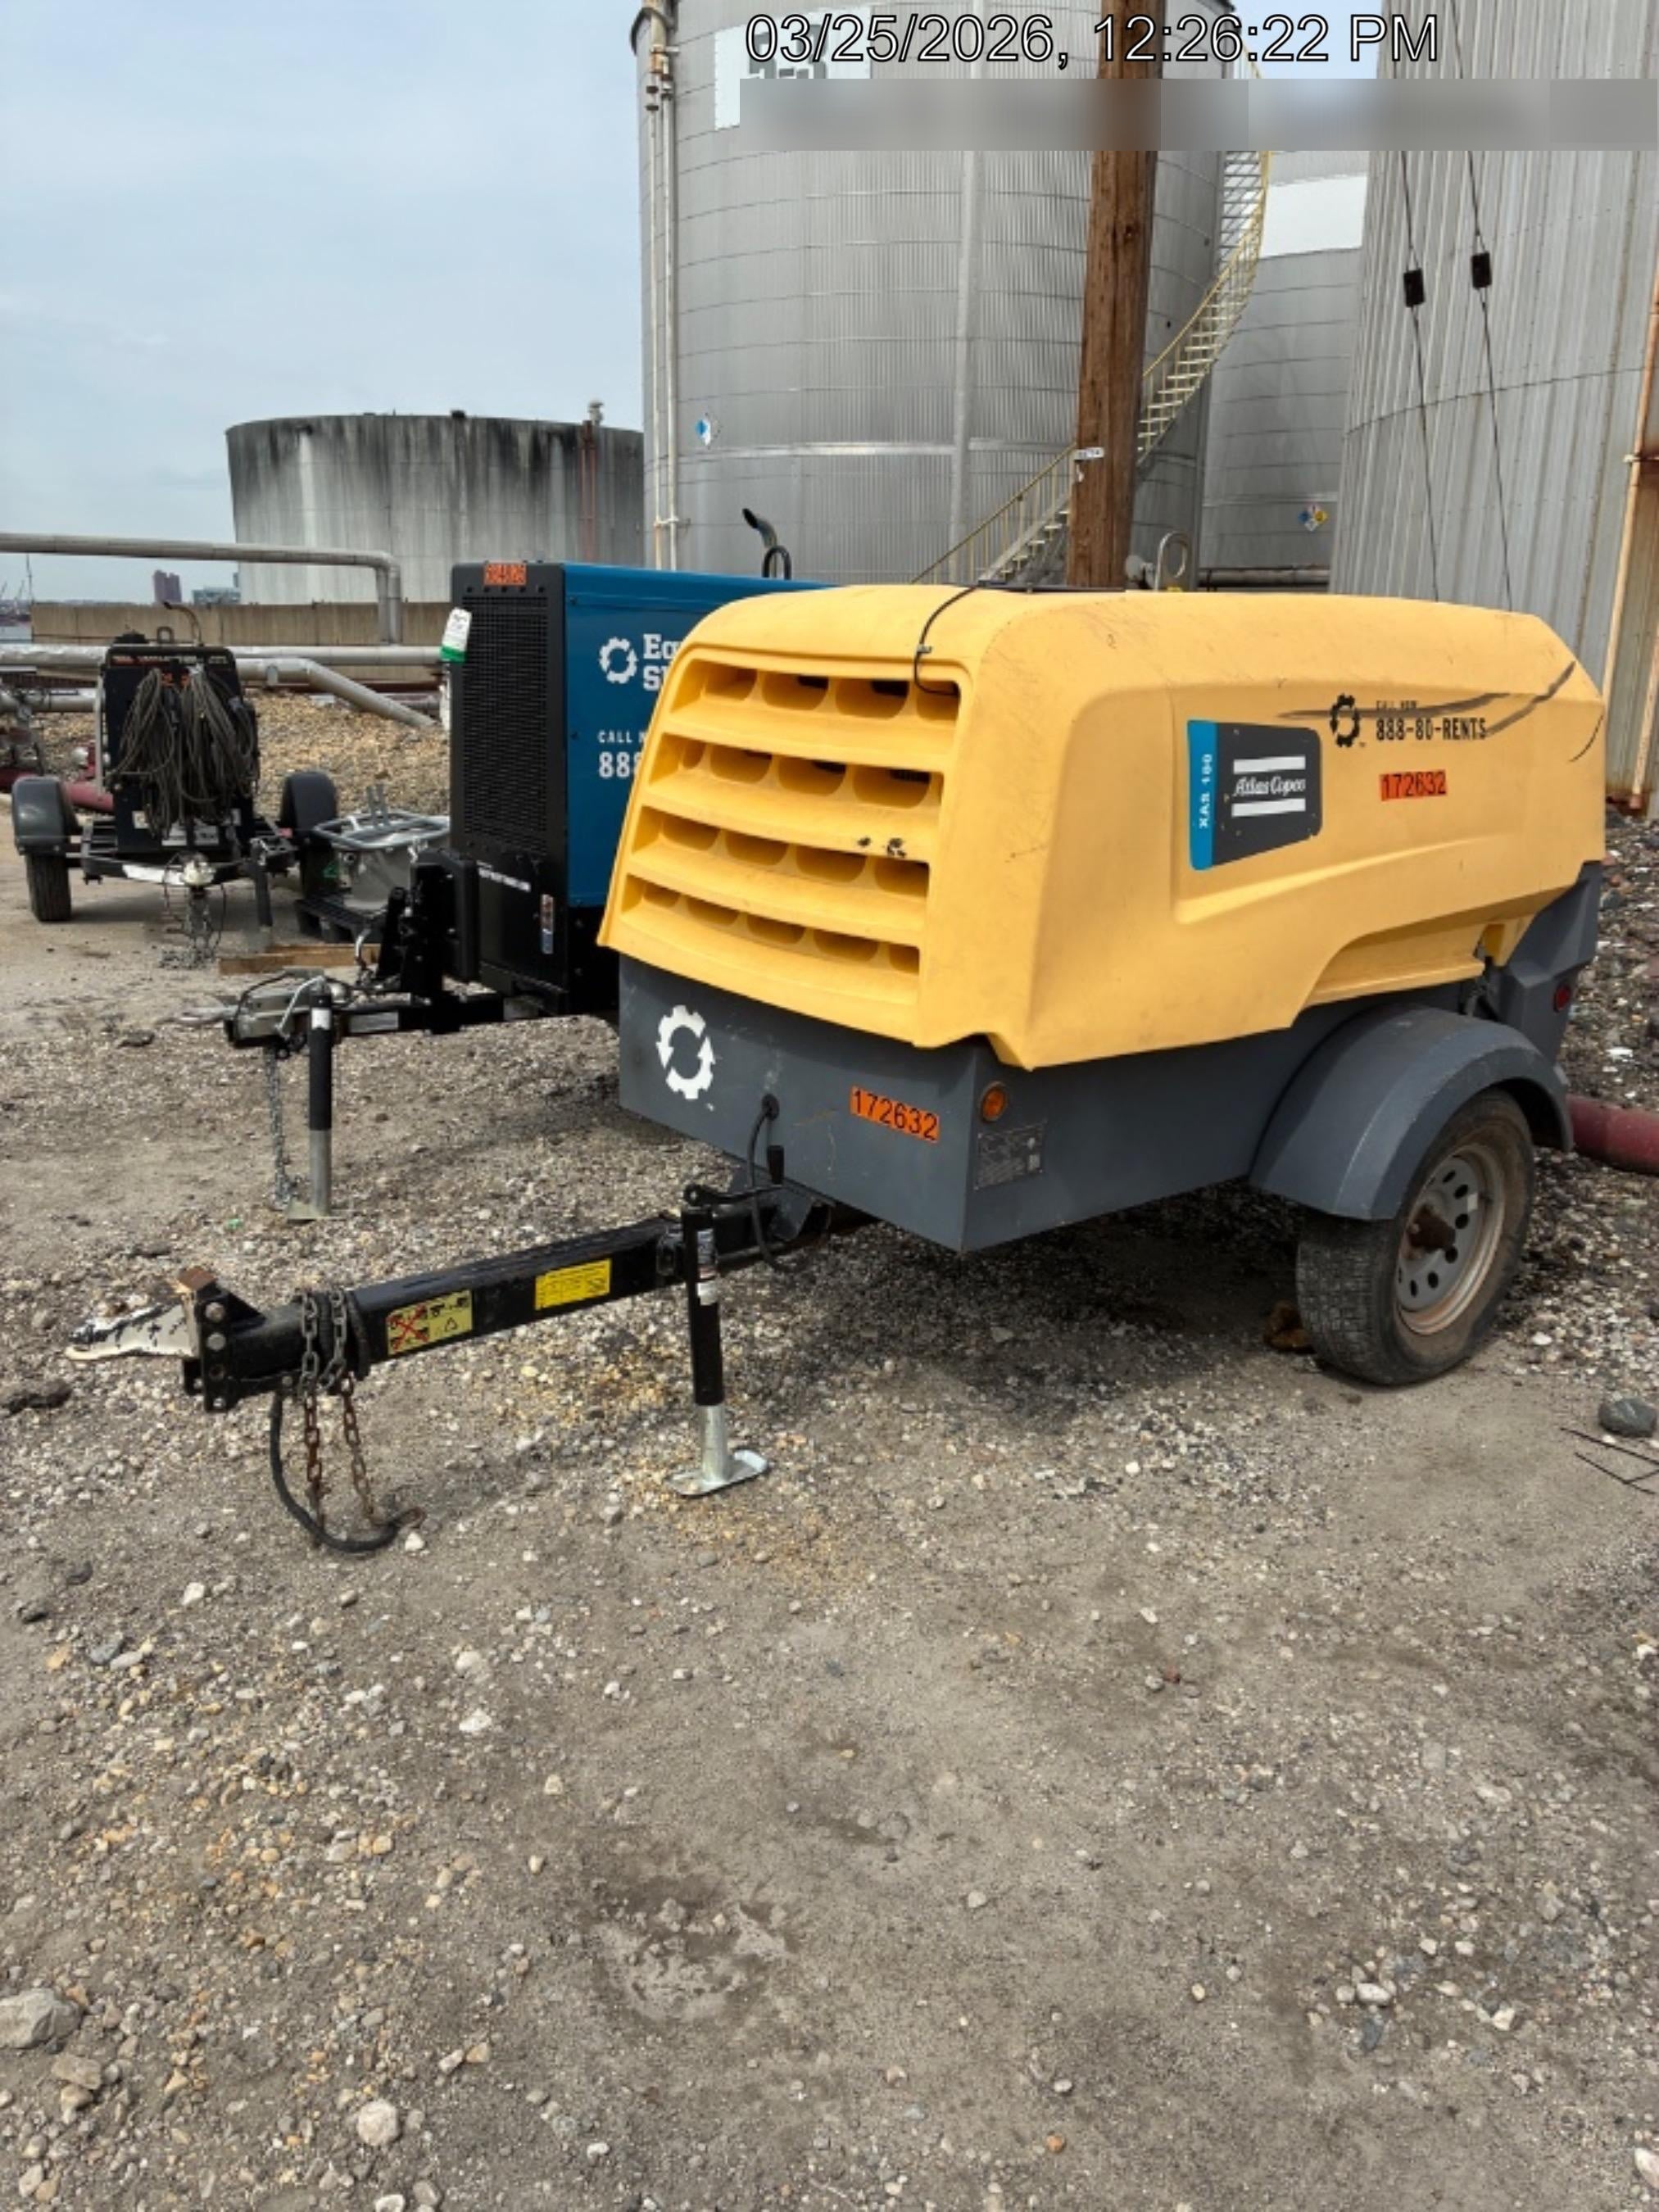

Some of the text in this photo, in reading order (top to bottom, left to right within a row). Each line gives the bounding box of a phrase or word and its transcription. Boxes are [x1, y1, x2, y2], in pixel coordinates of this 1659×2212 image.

[597, 730, 632, 744] CALL
[1376, 718, 1486, 741] 888-80-RENTS
[1232, 775, 1307, 797] Atlas Copco
[1380, 770, 1447, 800] 172632
[854, 1089, 938, 1141] 172632
